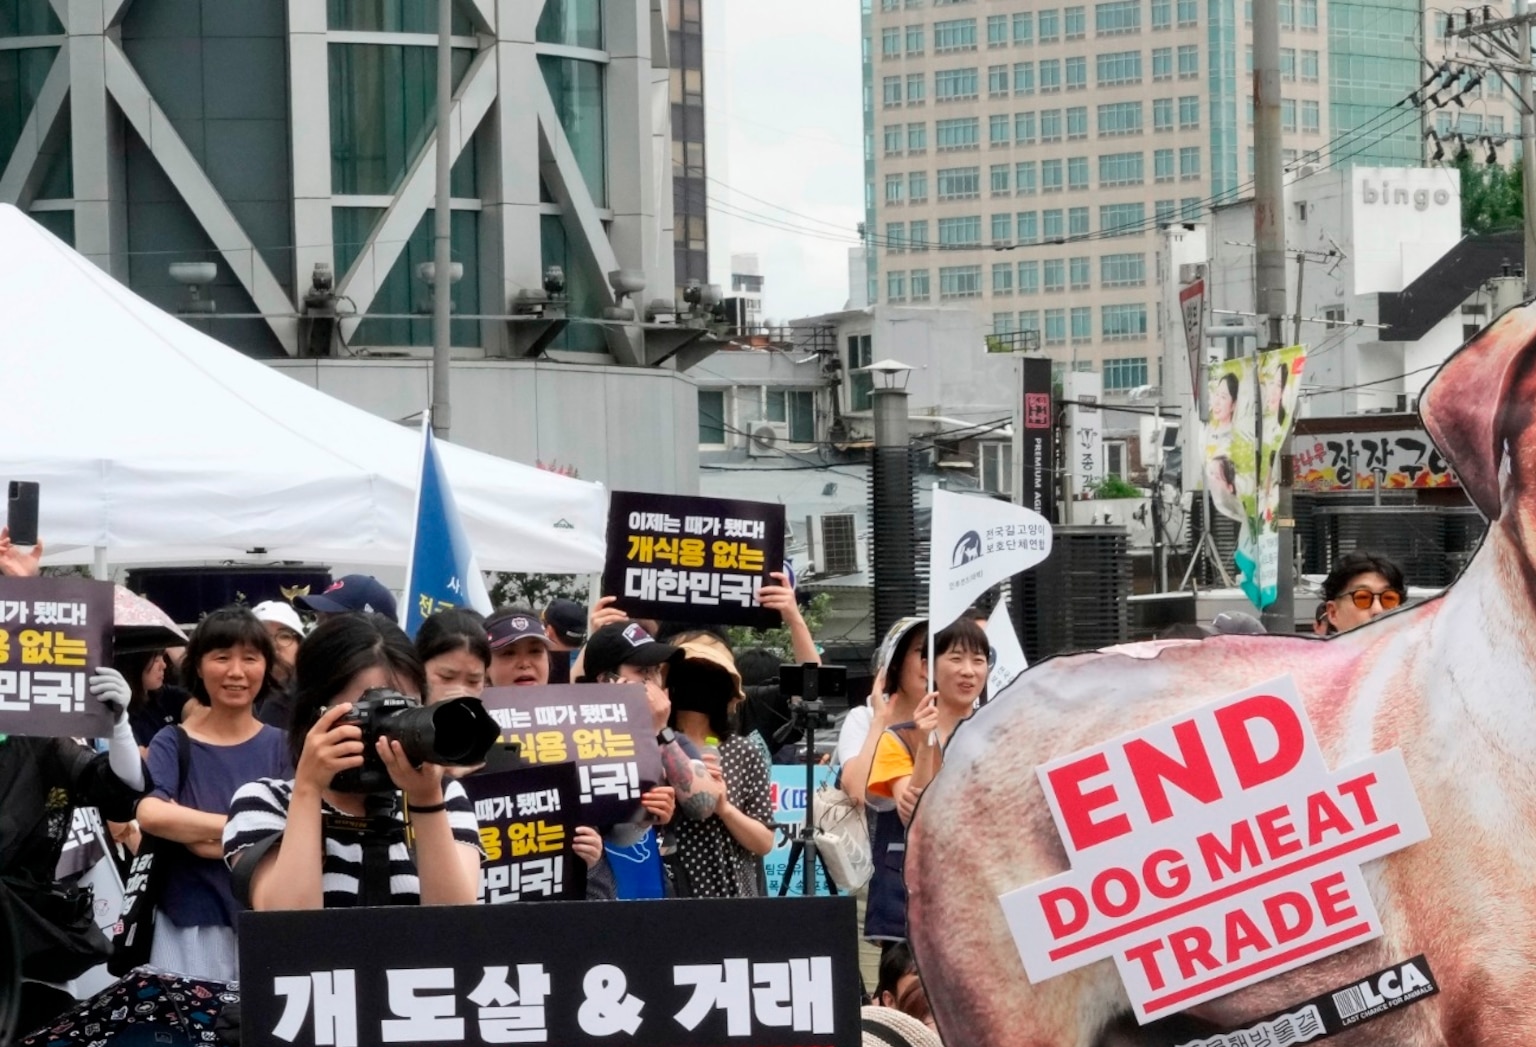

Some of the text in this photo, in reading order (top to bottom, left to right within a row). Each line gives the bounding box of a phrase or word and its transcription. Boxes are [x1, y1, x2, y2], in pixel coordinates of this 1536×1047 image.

[1363, 179, 1449, 211] bingo
[628, 511, 765, 539] 이제는 때가 됐다!
[986, 524, 1046, 541] 전국길고양이
[627, 535, 765, 571] 개식용 없는
[986, 539, 1046, 554] 보호단체연합
[624, 567, 763, 607] 대한민국!
[34, 601, 87, 625] 됐다!
[19, 629, 88, 665] 없는
[535, 705, 576, 726] 때가
[580, 703, 628, 723] 됐다!
[572, 728, 635, 760] 없는
[1047, 694, 1305, 852] END
[516, 788, 561, 816] 됐다!
[508, 820, 565, 856] 없는
[1038, 772, 1379, 940] DOG MEAT
[1124, 871, 1358, 991] TRADE
[380, 963, 550, 1044] 도살
[577, 963, 645, 1038] &
[673, 955, 834, 1037] 거래
[1360, 963, 1430, 1007] LCA
[1342, 984, 1434, 1026] LAST CHANCE FOR ANIMALS
